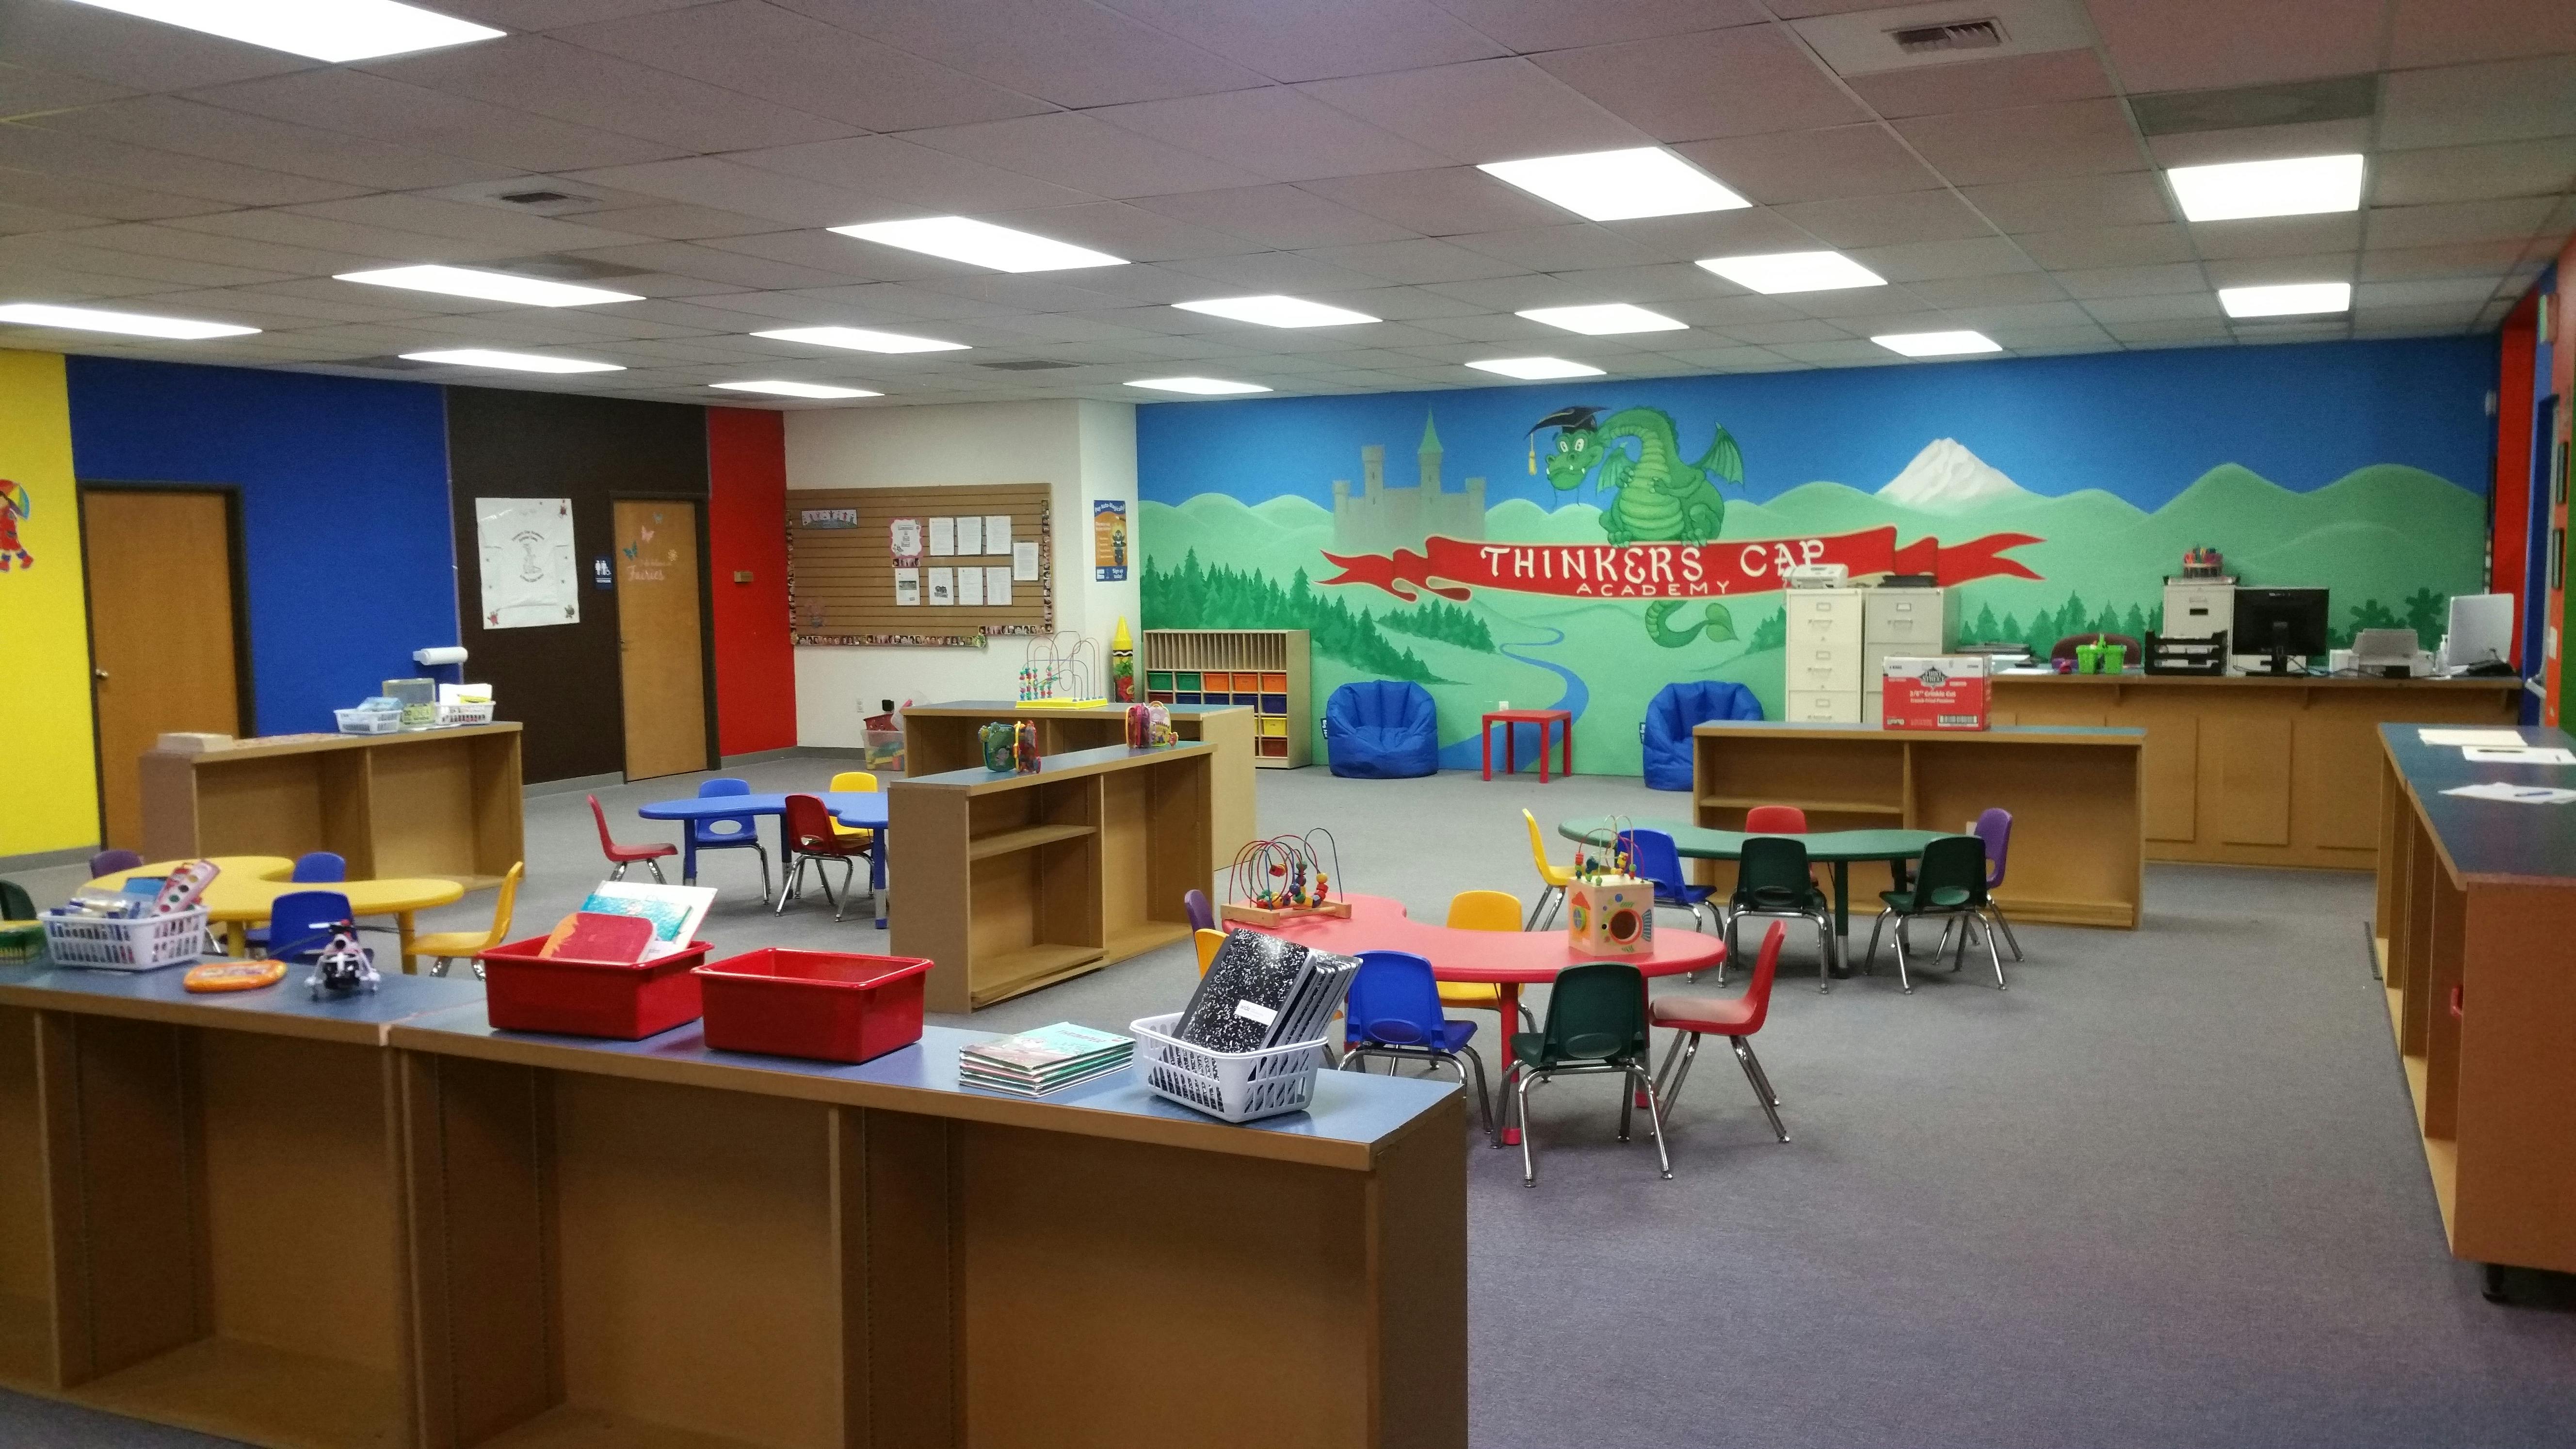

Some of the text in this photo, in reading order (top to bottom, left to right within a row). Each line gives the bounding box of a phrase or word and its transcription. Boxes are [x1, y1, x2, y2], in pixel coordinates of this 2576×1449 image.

[1480, 539, 1825, 583] THINKERS CAP
[1576, 580, 1730, 596] ACADEMY
